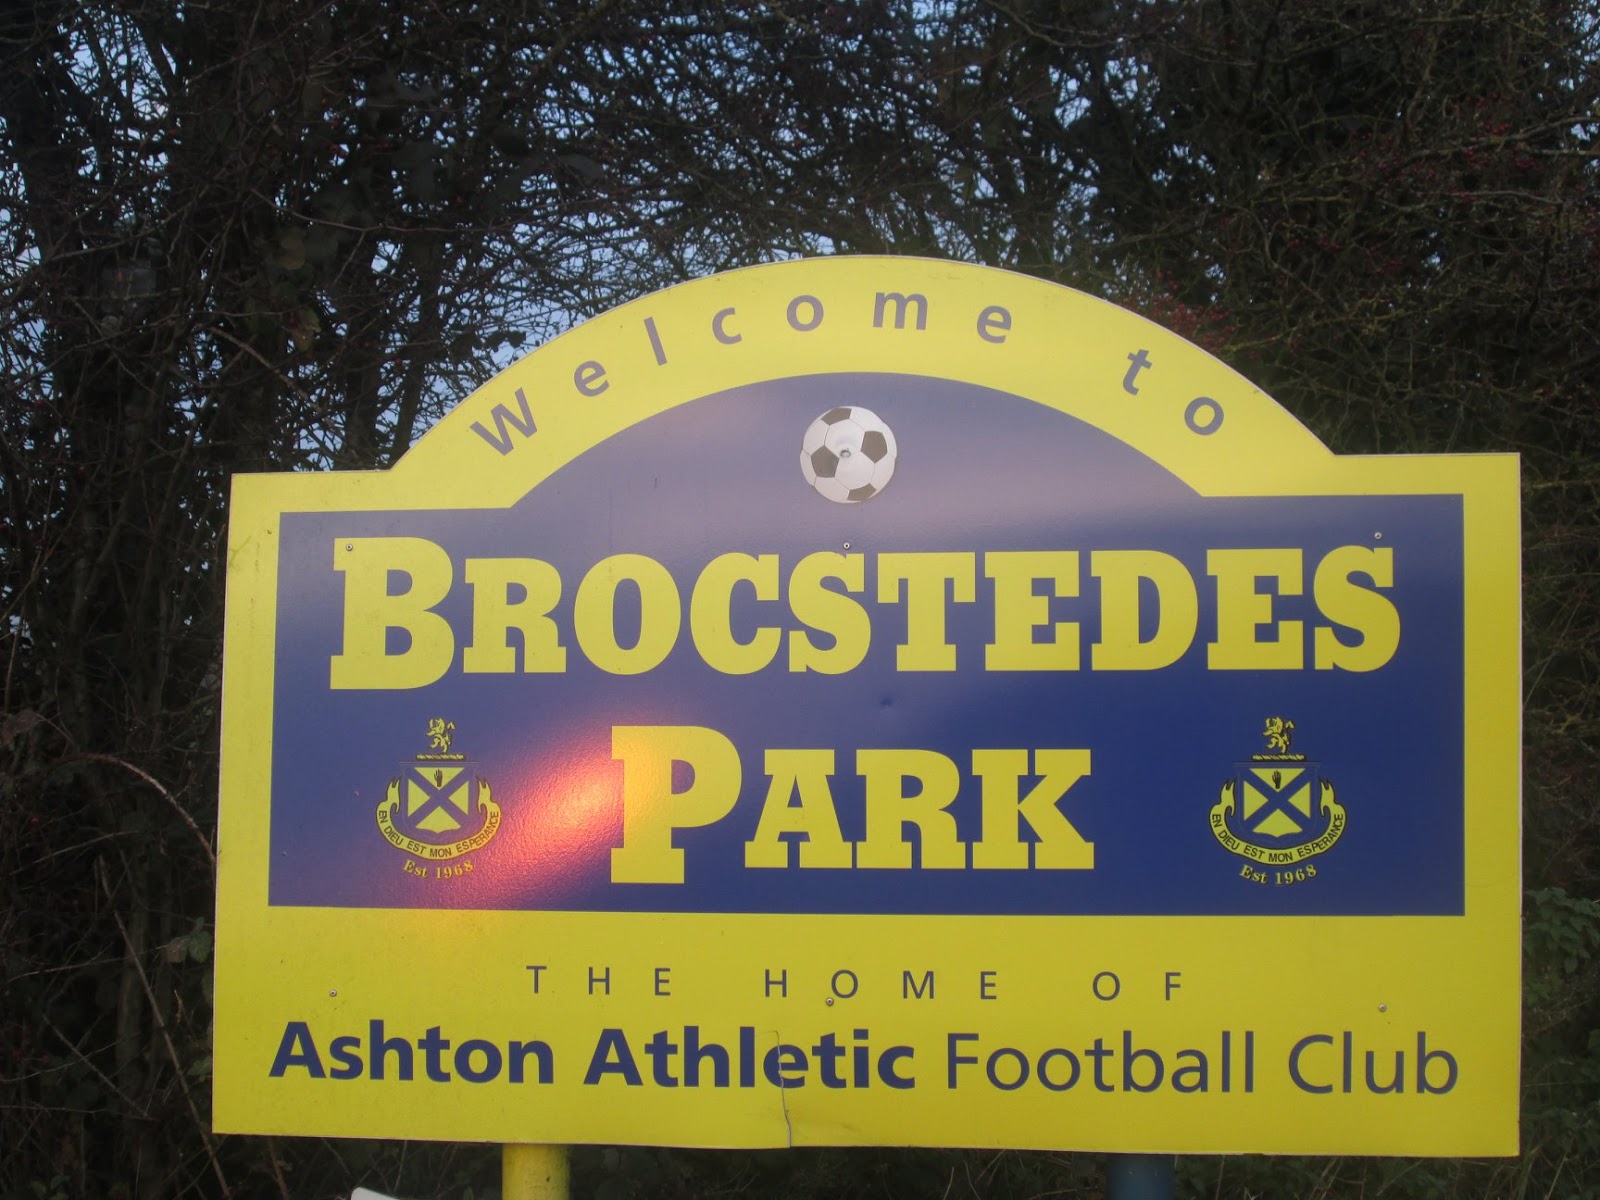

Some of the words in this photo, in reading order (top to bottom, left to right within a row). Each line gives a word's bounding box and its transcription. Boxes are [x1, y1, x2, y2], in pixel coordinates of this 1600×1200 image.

[470, 290, 1013, 457] Welcome
[1122, 348, 1225, 437] to
[329, 536, 1402, 690] BROCSTEDES
[610, 725, 1095, 885] PARK
[379, 810, 388, 824] EN
[384, 825, 403, 845] DIEU
[406, 840, 427, 855] EST
[429, 847, 452, 858] MON
[455, 811, 499, 853] ESPERANCE
[1212, 813, 1222, 828] EN
[1218, 829, 1240, 850] DIEU
[1243, 845, 1265, 860] EST
[1268, 852, 1293, 863] MON
[1297, 813, 1343, 858] ESPERANCE
[403, 859, 428, 878] Est
[436, 860, 475, 879] 1968
[1239, 864, 1267, 884] Est
[1275, 864, 1317, 885] 1968
[526, 965, 671, 997] THE
[764, 968, 998, 1001] HOME
[1092, 971, 1182, 1002] OF
[268, 1019, 555, 1085] Ashton
[583, 1025, 916, 1089] Athletic
[946, 1030, 1255, 1094] Football
[1288, 1030, 1459, 1095] Club
